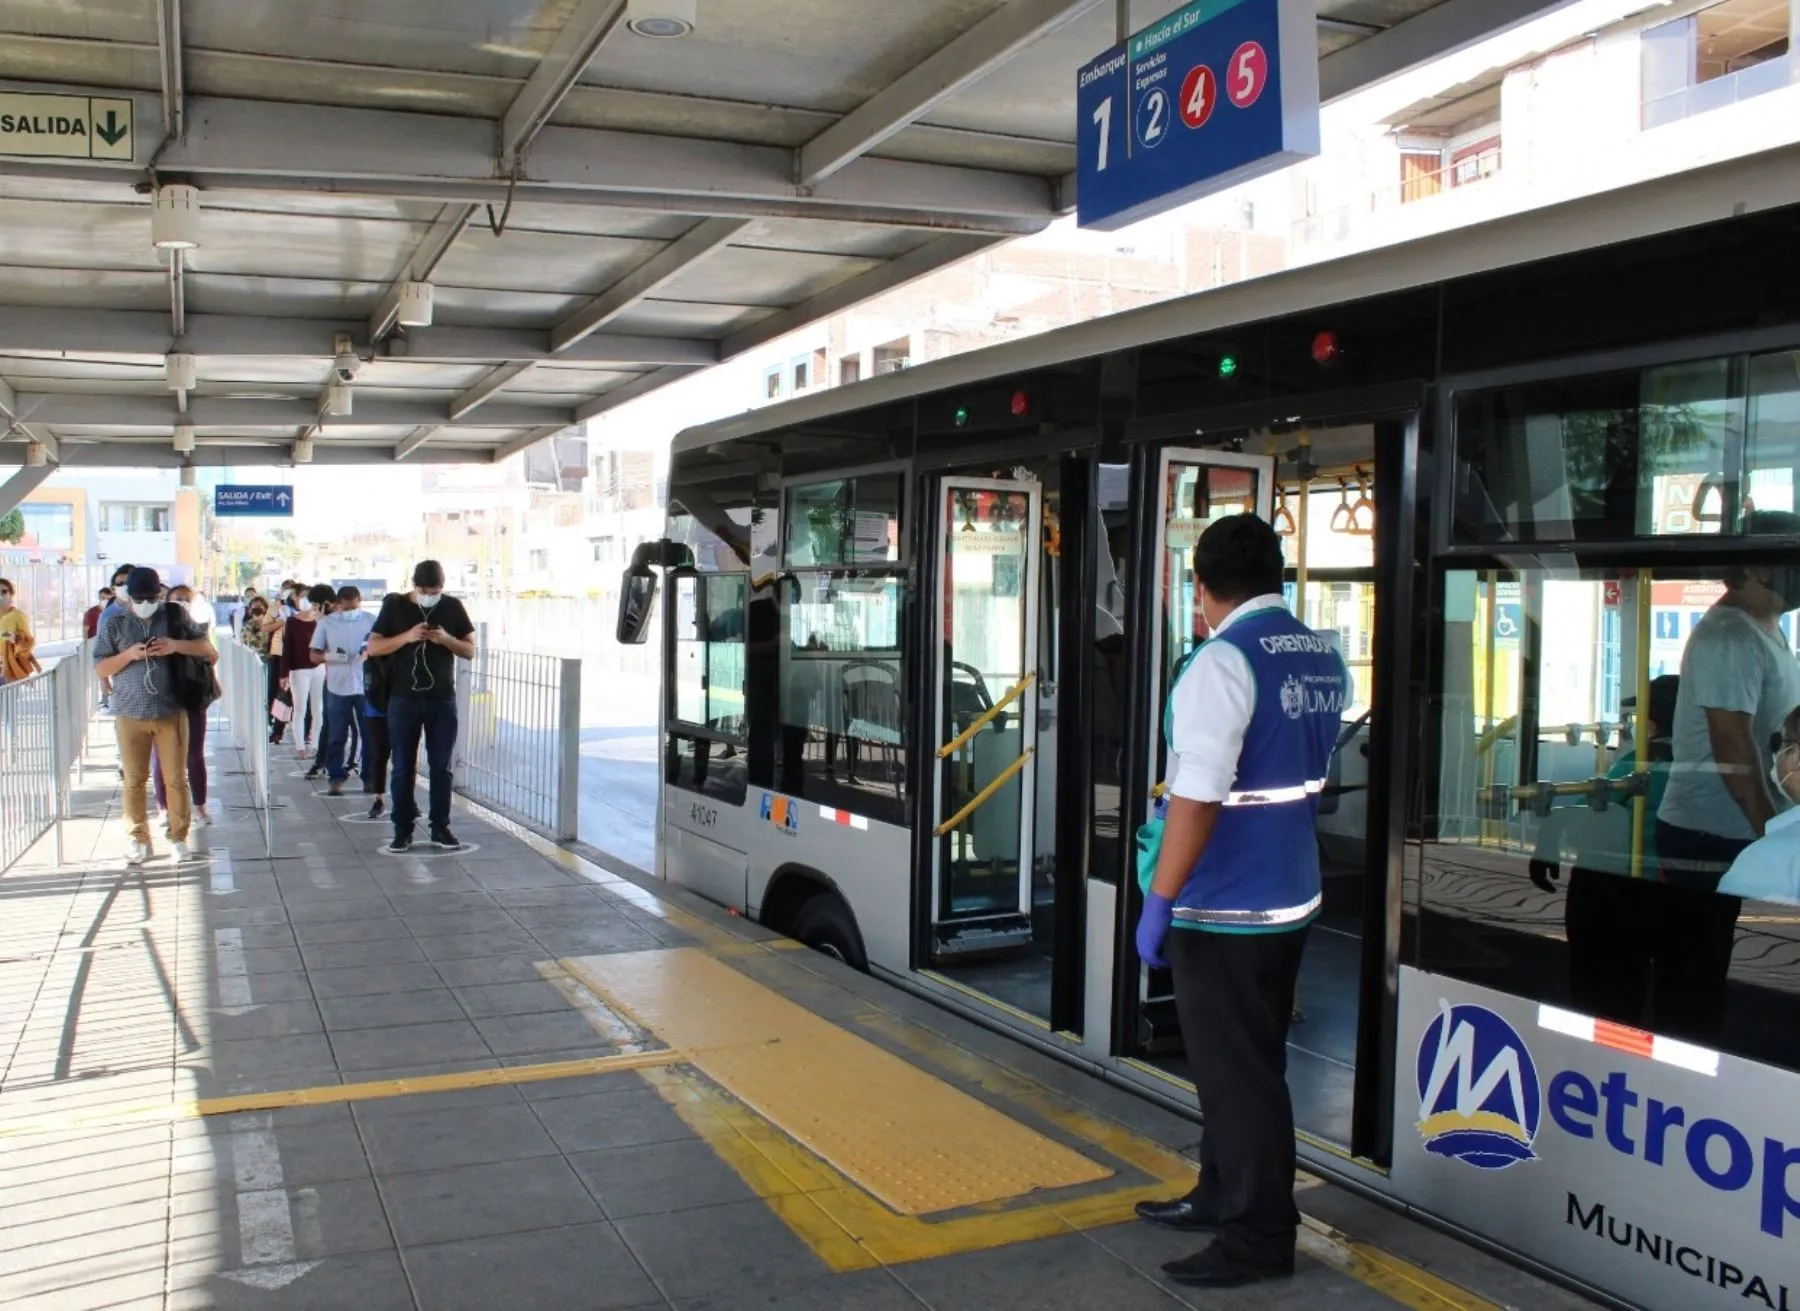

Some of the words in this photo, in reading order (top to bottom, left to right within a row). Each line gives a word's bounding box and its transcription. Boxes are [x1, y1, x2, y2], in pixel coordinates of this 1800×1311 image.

[1172, 17, 1183, 34] el
[1183, 8, 1202, 29] Sur
[1079, 53, 1126, 88] Embarque
[1135, 52, 1168, 75] Servicios
[1144, 91, 1164, 142] 2
[1186, 72, 1206, 120] 4
[1235, 48, 1256, 100] 5
[0, 114, 87, 136] SALIDA
[1092, 95, 1113, 172] 1
[217, 491, 249, 500] SALIDA
[255, 491, 273, 500] Exit
[1259, 633, 1333, 655] ORIENTADOR
